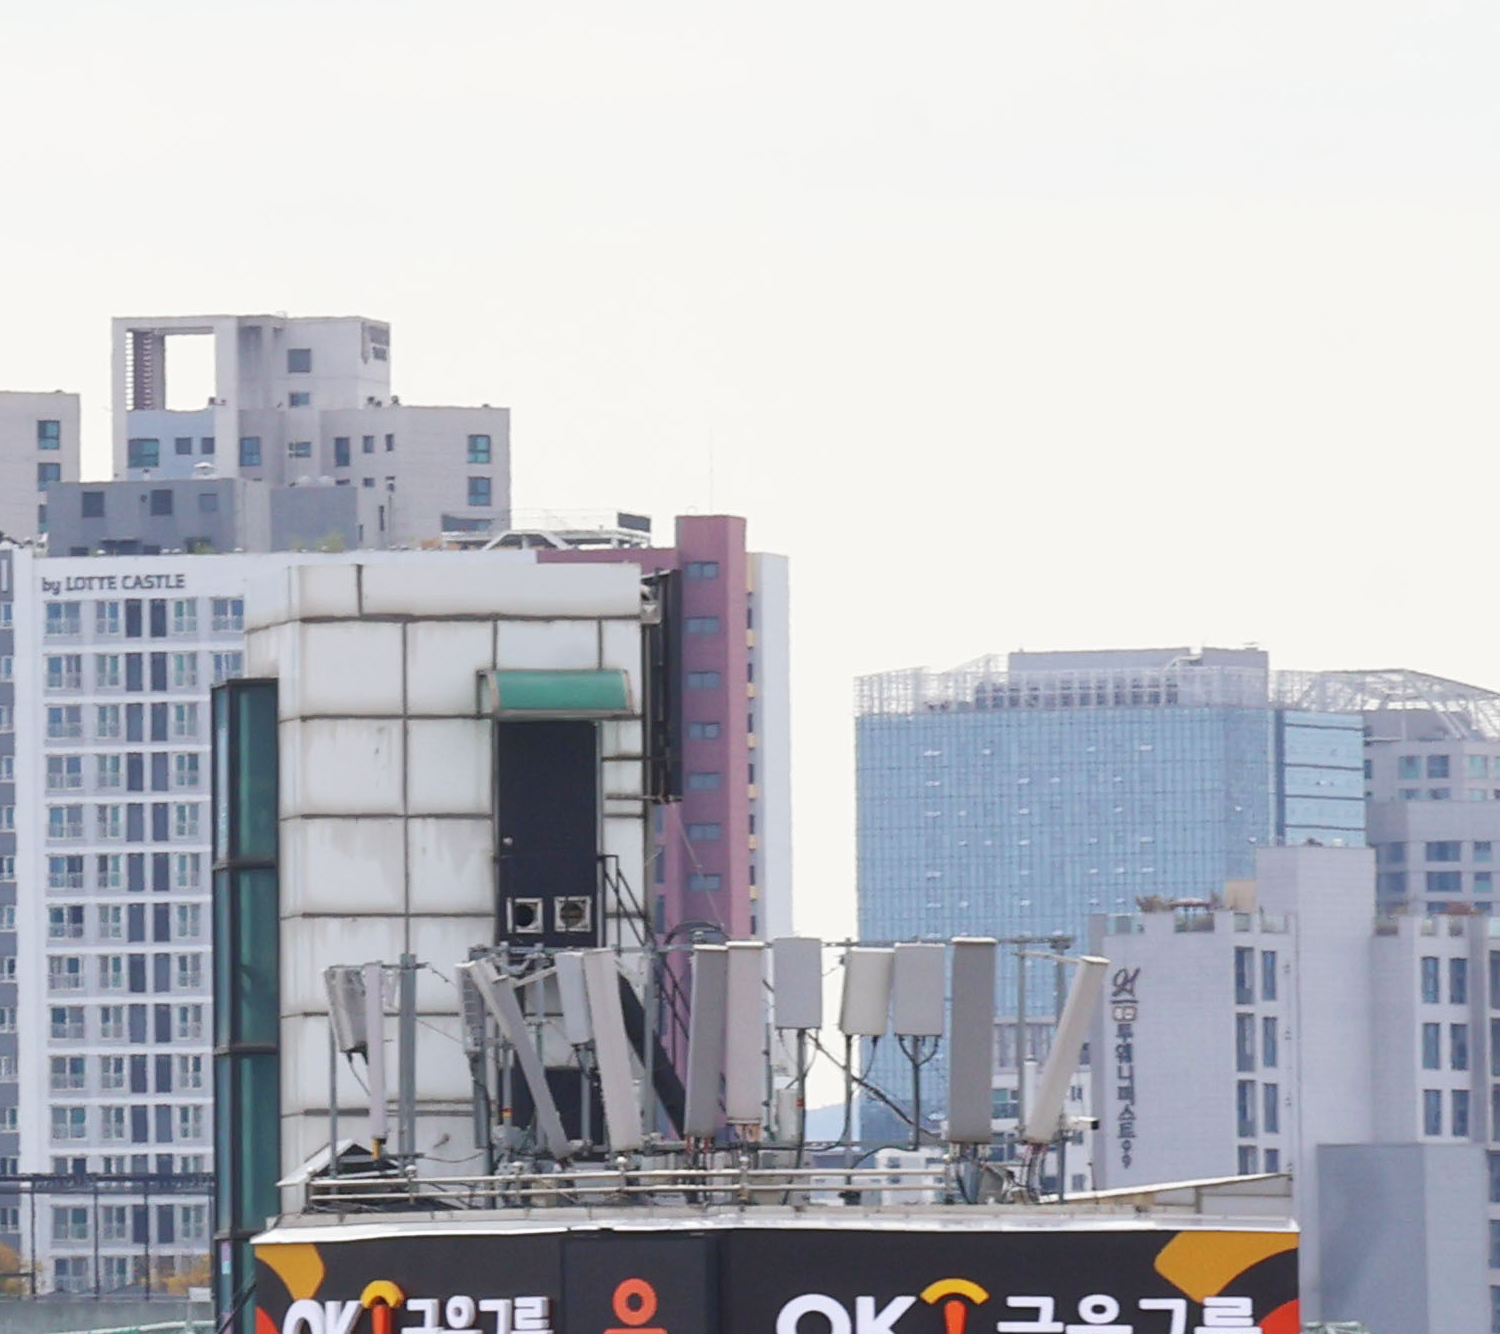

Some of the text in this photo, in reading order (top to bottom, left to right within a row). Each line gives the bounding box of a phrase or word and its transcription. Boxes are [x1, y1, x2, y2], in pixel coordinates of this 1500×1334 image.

[41, 574, 186, 595] by LOTTE CASTLE
